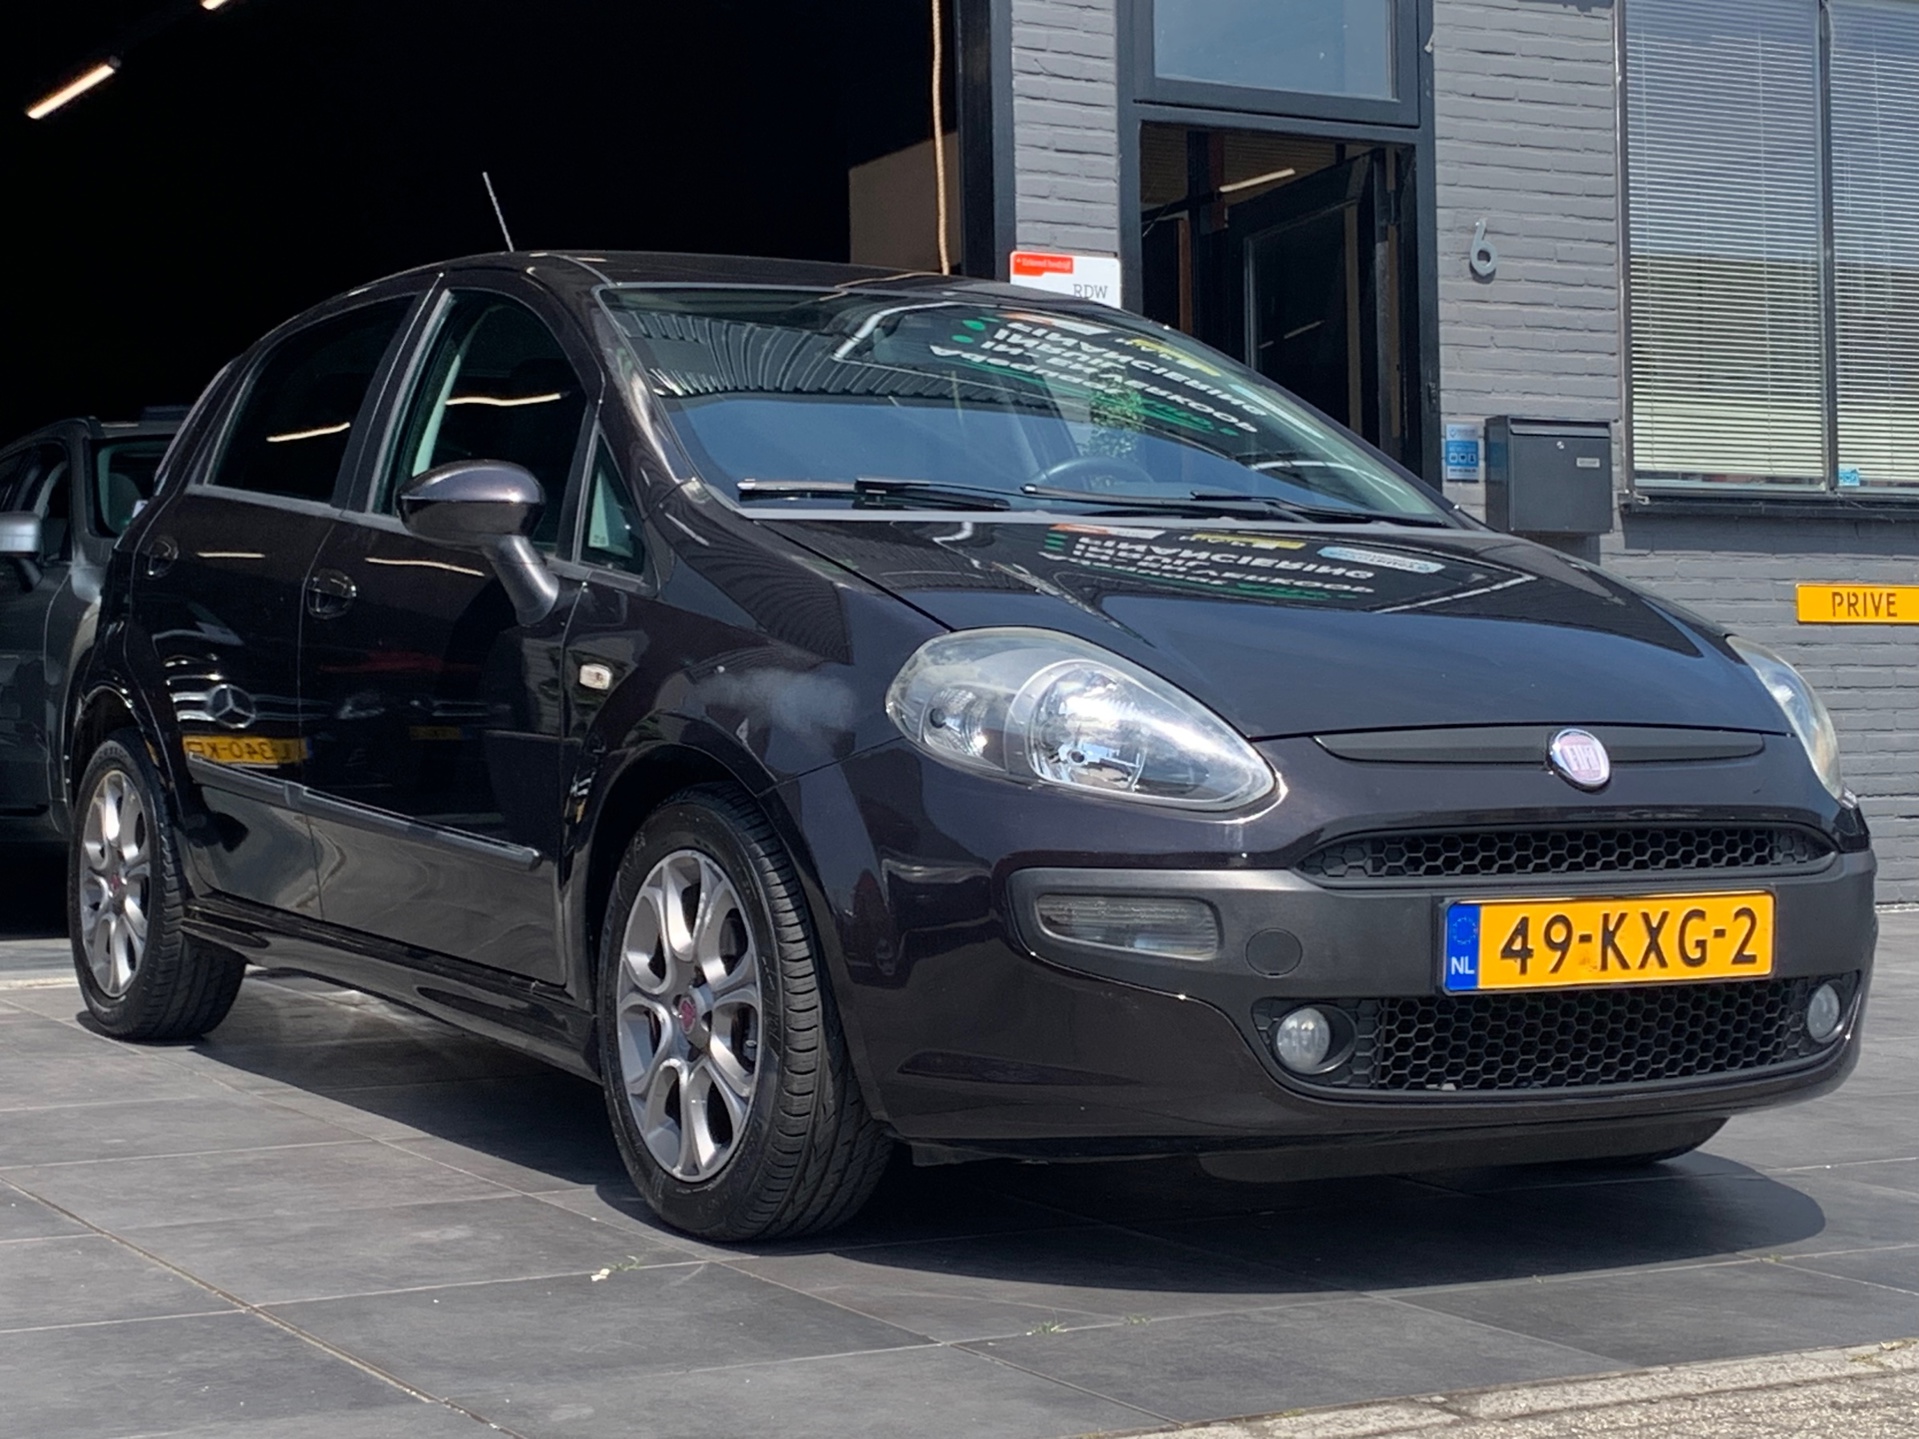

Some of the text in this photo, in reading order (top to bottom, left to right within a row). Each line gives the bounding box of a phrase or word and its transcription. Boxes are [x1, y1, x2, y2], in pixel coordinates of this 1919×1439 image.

[1470, 218, 1497, 276] 6
[1073, 284, 1108, 299] RDW
[1831, 592, 1898, 617] PRIVE
[1500, 906, 1758, 975] 49-KXG-2
[1450, 956, 1475, 975] NL
